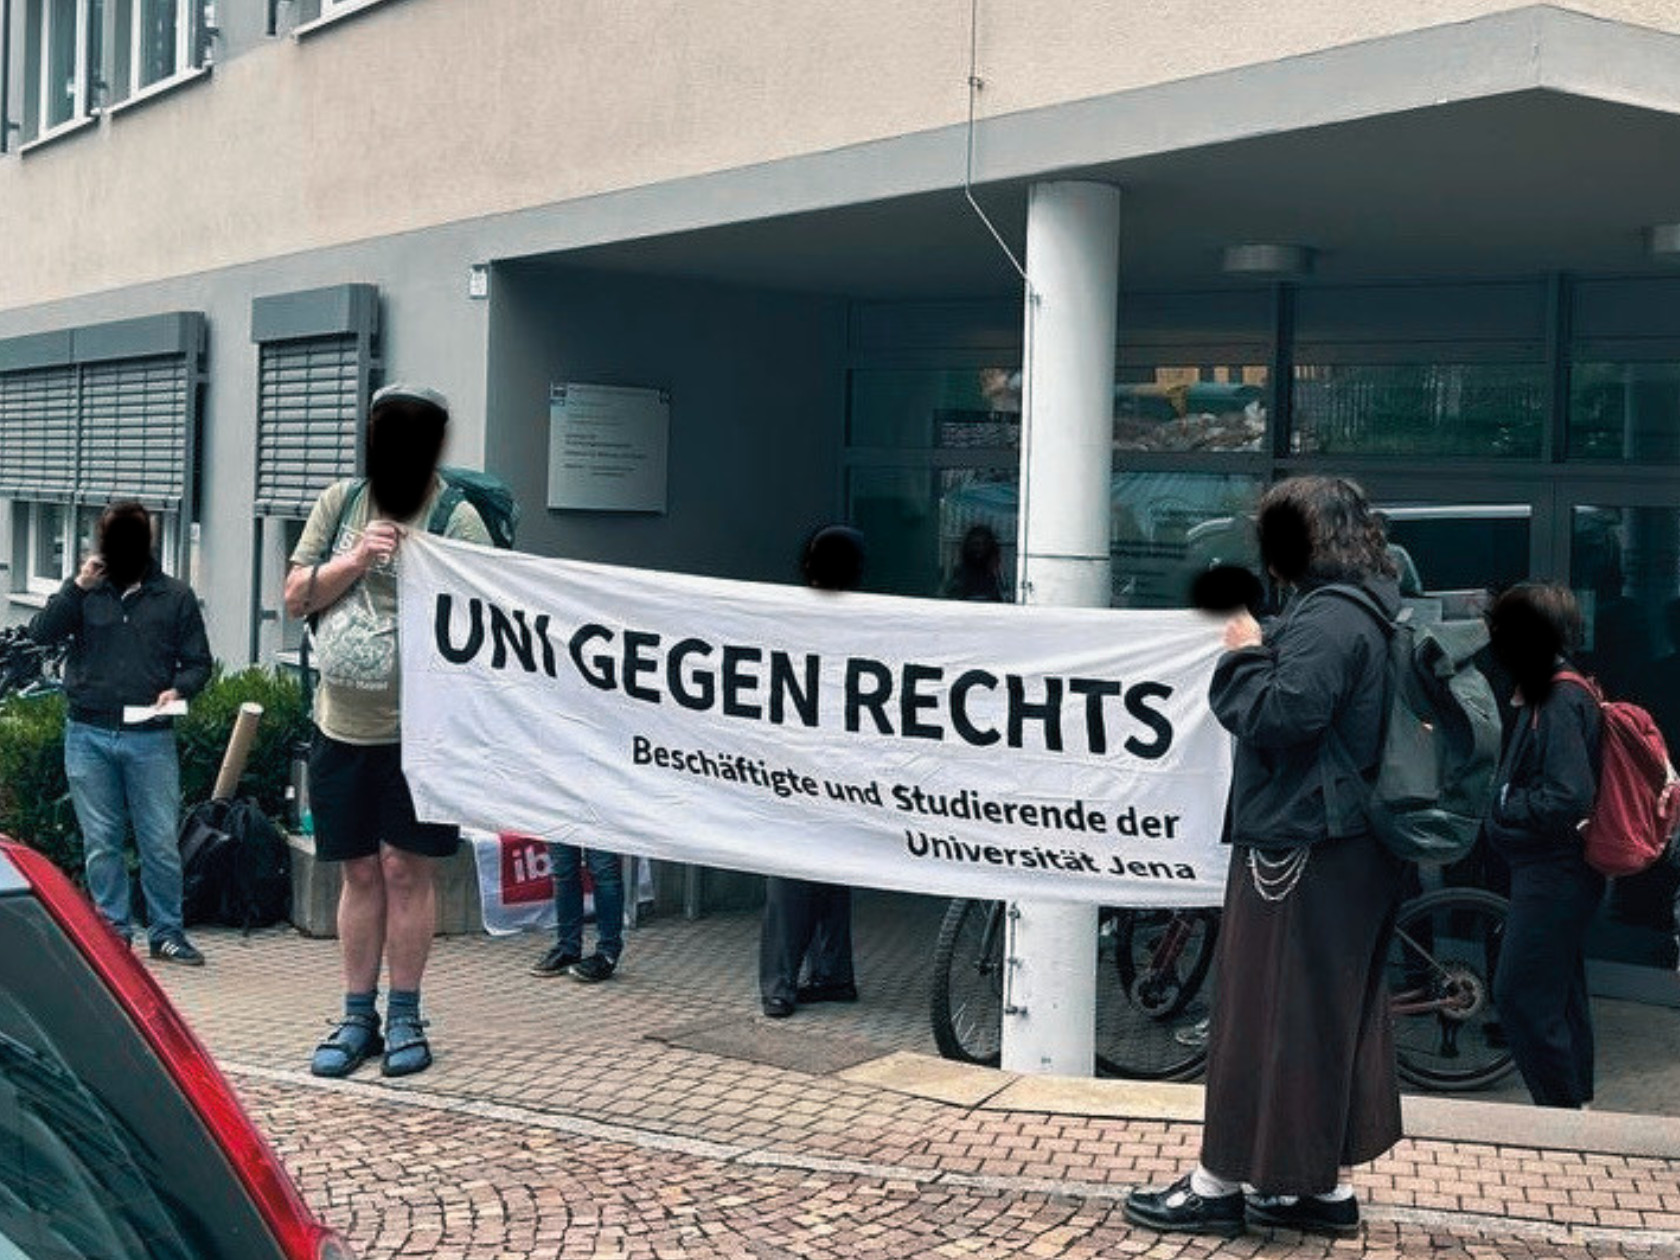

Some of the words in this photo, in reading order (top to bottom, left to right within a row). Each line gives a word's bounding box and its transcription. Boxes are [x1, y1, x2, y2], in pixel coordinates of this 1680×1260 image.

[434, 593, 557, 678] UNI
[568, 623, 820, 728] GEGEN
[844, 657, 1174, 760] RECHTS
[632, 735, 819, 798] Beschäftigte
[824, 779, 884, 807] und
[891, 784, 1107, 834] Studierende
[1116, 806, 1180, 839] der
[905, 830, 1102, 873] Universität
[1108, 856, 1196, 880] Jena
